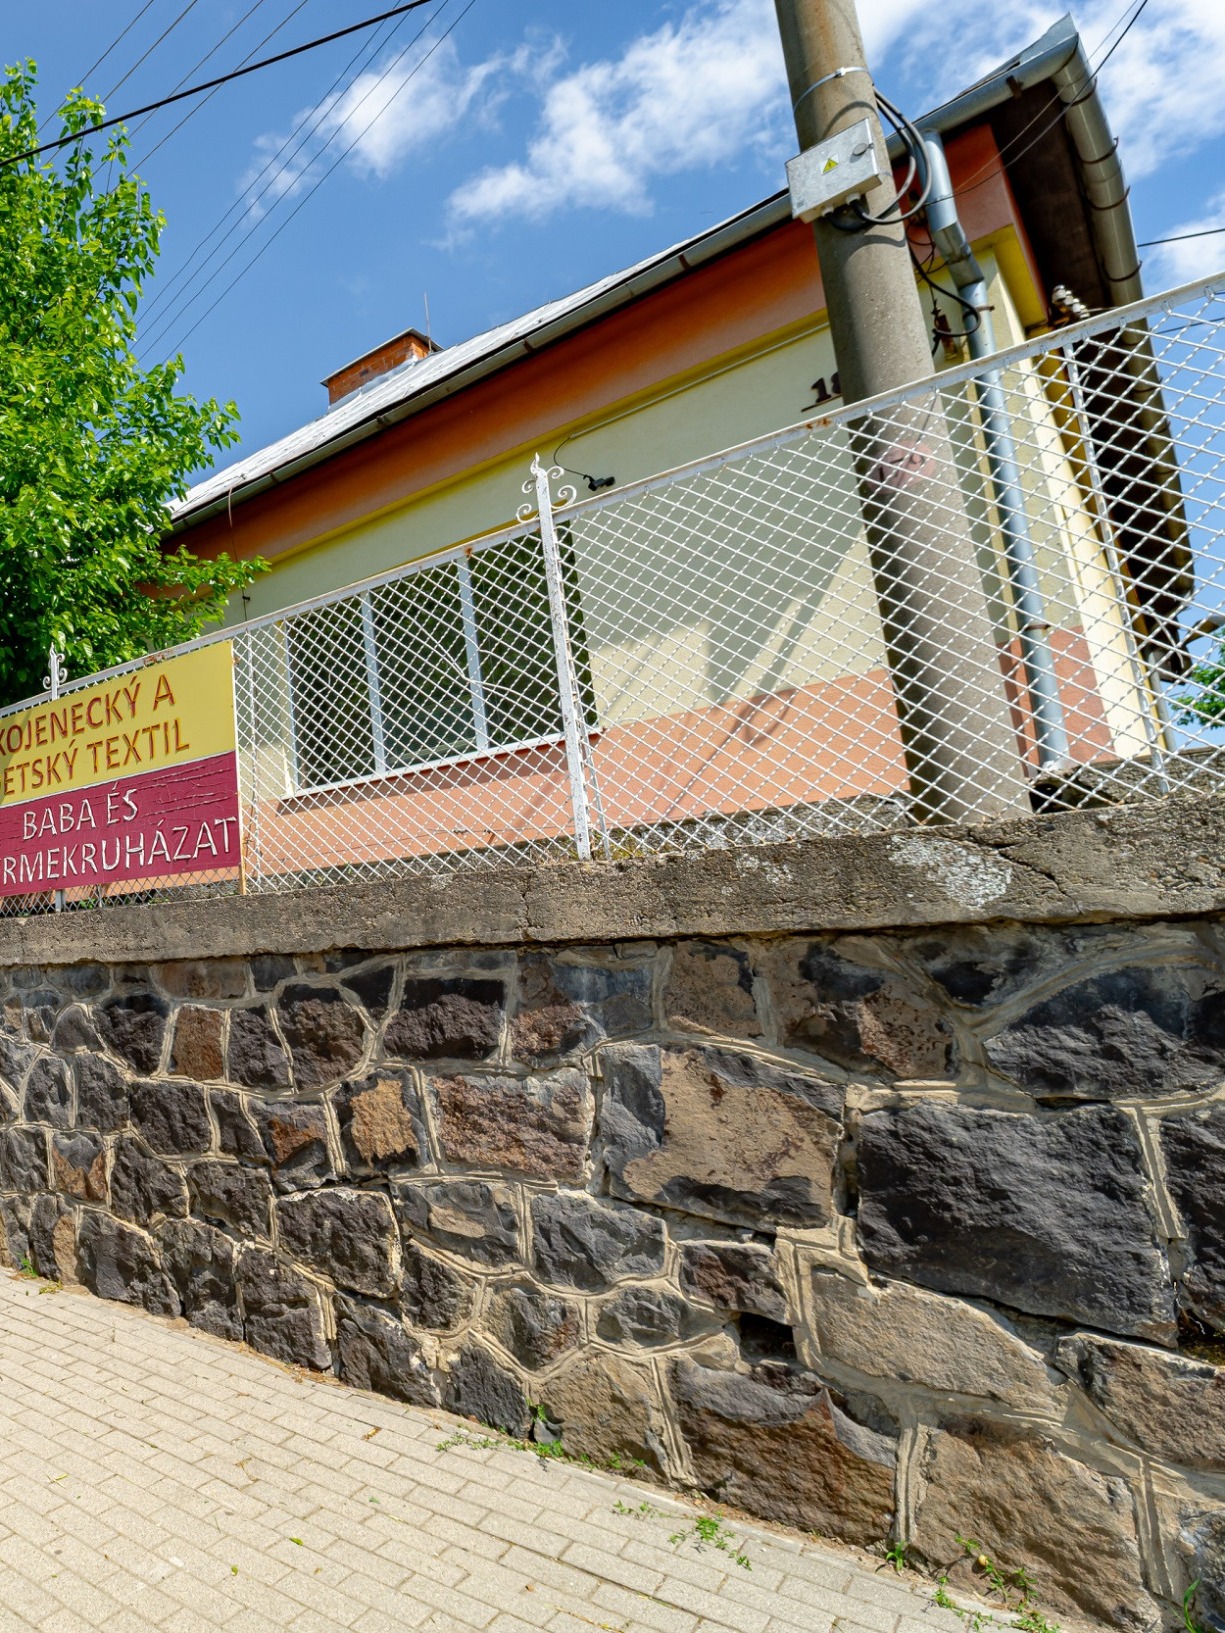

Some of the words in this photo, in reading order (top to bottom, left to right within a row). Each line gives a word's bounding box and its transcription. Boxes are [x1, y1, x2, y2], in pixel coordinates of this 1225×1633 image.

[153, 673, 177, 711] A
[86, 718, 190, 774] TEXTIL
[23, 799, 97, 841] BABA
[107, 781, 139, 825] ÉS
